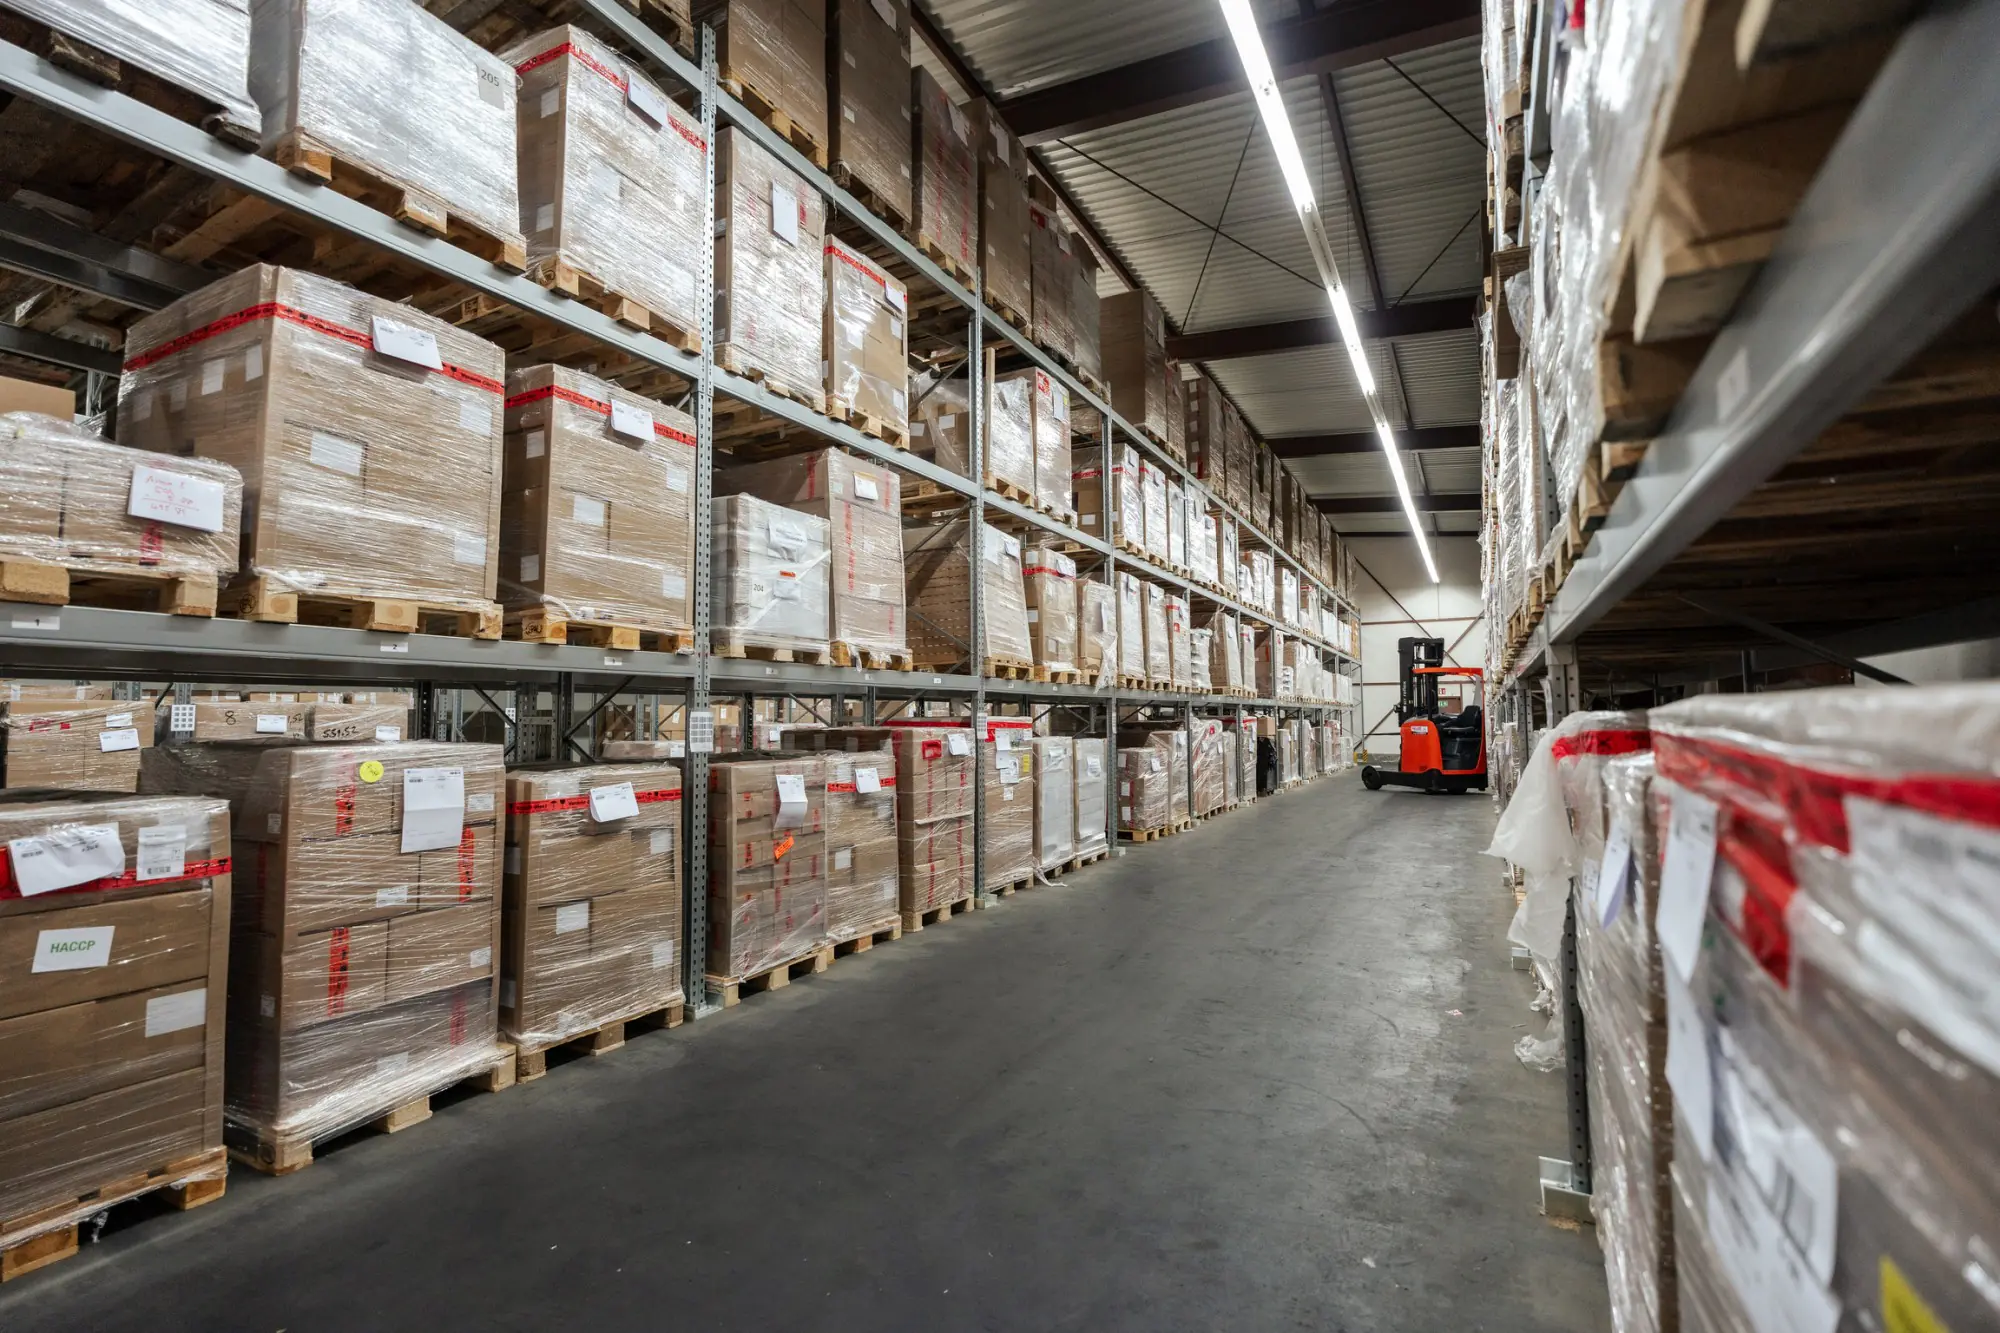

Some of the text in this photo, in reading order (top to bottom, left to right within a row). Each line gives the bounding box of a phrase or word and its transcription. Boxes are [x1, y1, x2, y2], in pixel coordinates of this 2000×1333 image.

[480, 69, 500, 87] 205
[753, 583, 764, 593] 204
[224, 710, 237, 726] 8
[50, 940, 96, 954] HACCP
